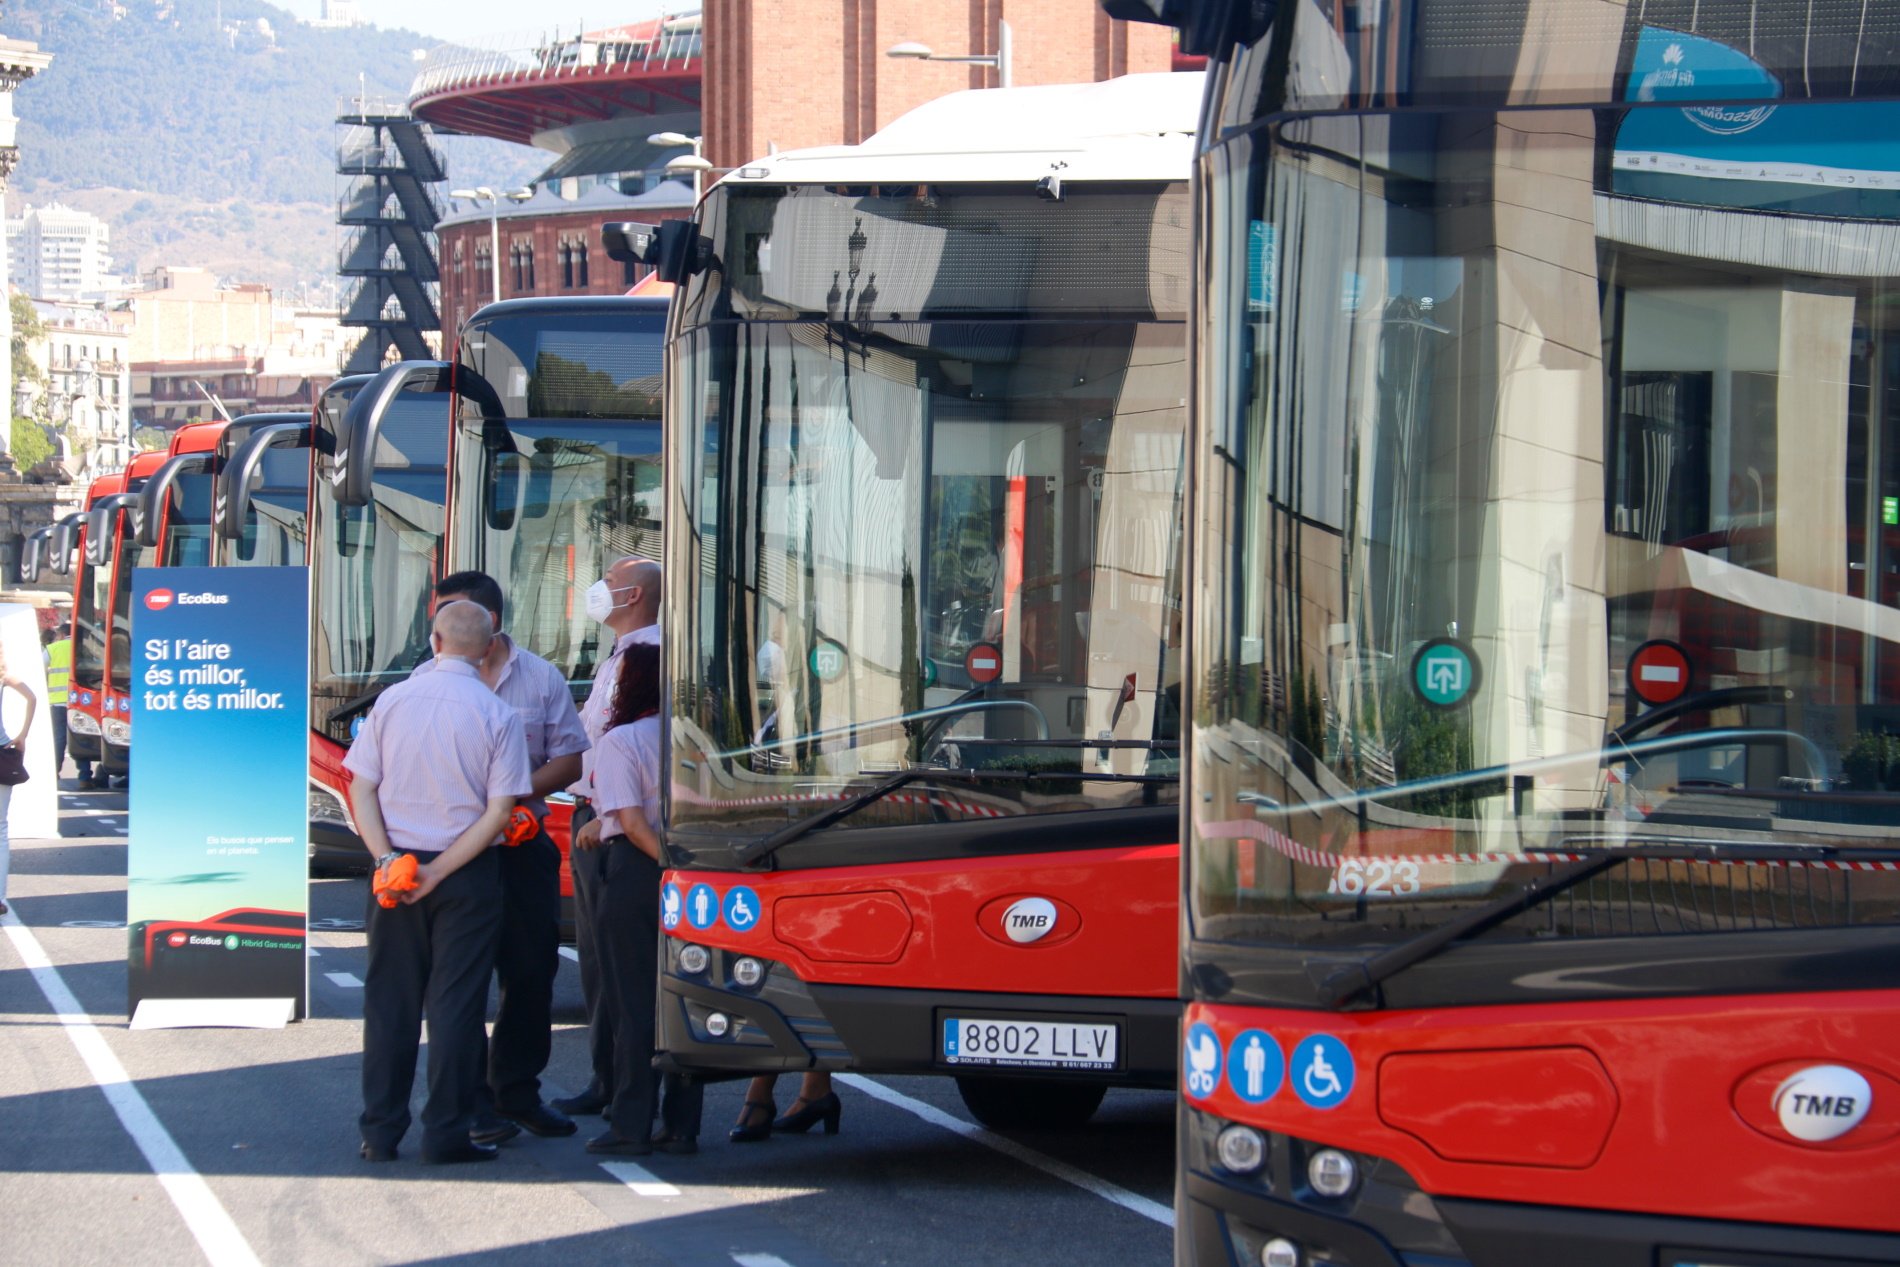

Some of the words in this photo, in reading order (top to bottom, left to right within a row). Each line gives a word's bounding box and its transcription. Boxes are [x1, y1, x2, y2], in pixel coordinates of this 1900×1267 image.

[177, 592, 229, 605] EcoBus
[145, 639, 169, 660] Si
[175, 639, 230, 660] l'aire
[144, 664, 173, 685] és
[179, 664, 246, 687] millor,
[144, 690, 177, 710] tot
[183, 689, 211, 710] és
[217, 688, 284, 709] millor.
[1012, 915, 1048, 928] TMB
[189, 936, 221, 945] EcoBus
[264, 941, 278, 949] Gas
[278, 942, 302, 950] natural
[948, 1041, 955, 1050] E
[966, 1024, 1039, 1055] 8802
[1052, 1027, 1108, 1058] LLV
[959, 1057, 991, 1065] SOLARIS
[1793, 1094, 1856, 1117] TMB
